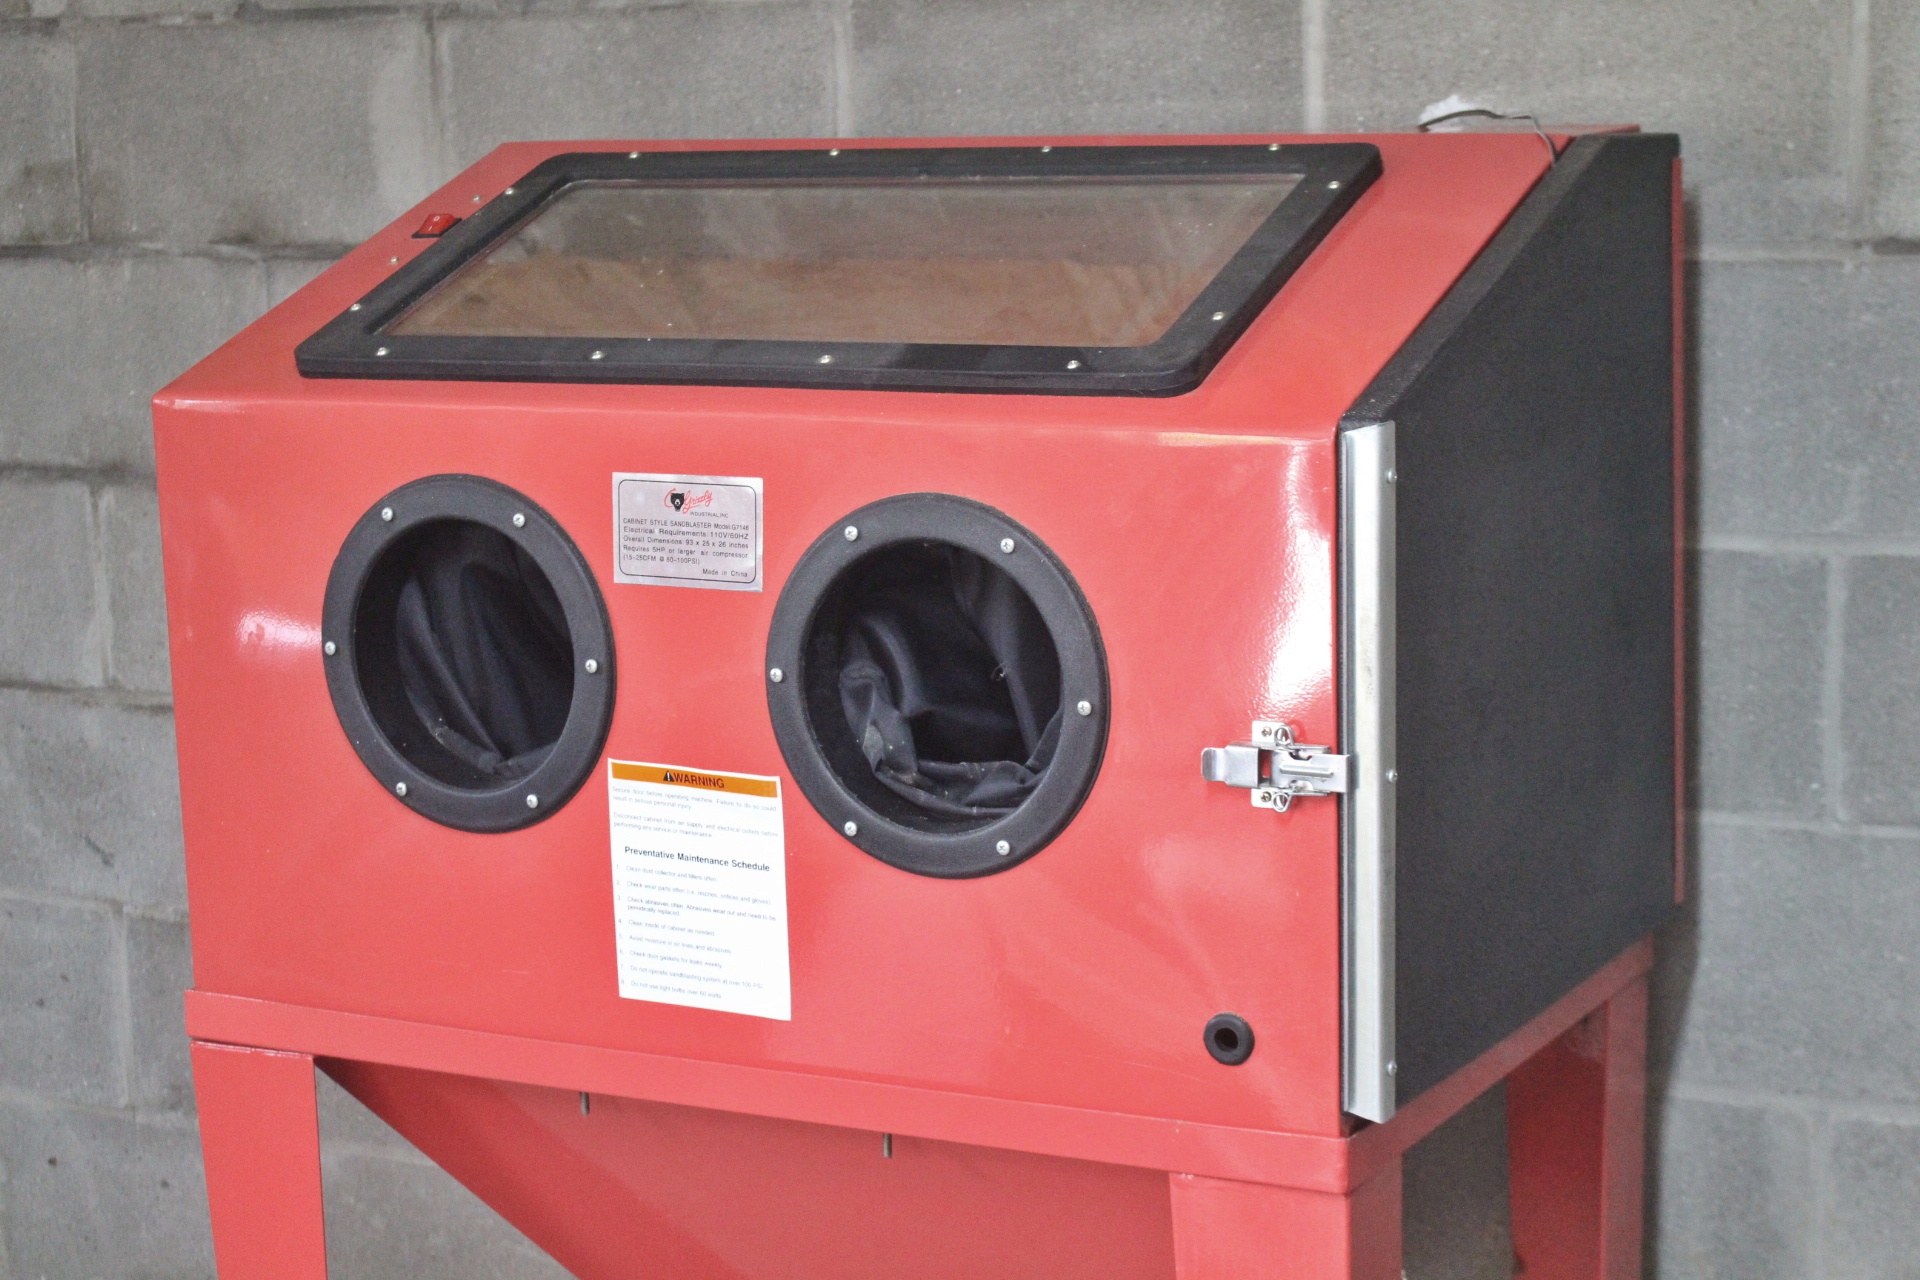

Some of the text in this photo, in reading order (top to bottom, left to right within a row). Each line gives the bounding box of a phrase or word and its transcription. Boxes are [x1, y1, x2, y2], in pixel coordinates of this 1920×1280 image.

[664, 488, 713, 514] Grizzly
[670, 521, 712, 529] SANDBLASTER
[623, 526, 749, 540] Electrical Requirements: 110V/60HZ
[623, 545, 649, 553] Requires
[678, 548, 696, 556] larger
[702, 568, 719, 576] Made
[673, 773, 725, 788] WARNING
[665, 793, 689, 801] operating
[716, 798, 734, 806] Failure
[613, 812, 642, 820] Disconnect
[716, 825, 740, 833] electrical
[613, 821, 642, 830] performing
[624, 846, 770, 872] Preventative Maintenance Schedule
[644, 899, 669, 907] abrasives
[627, 905, 656, 913] periodically
[629, 949, 645, 957] Check
[669, 972, 702, 981] sandblasting
